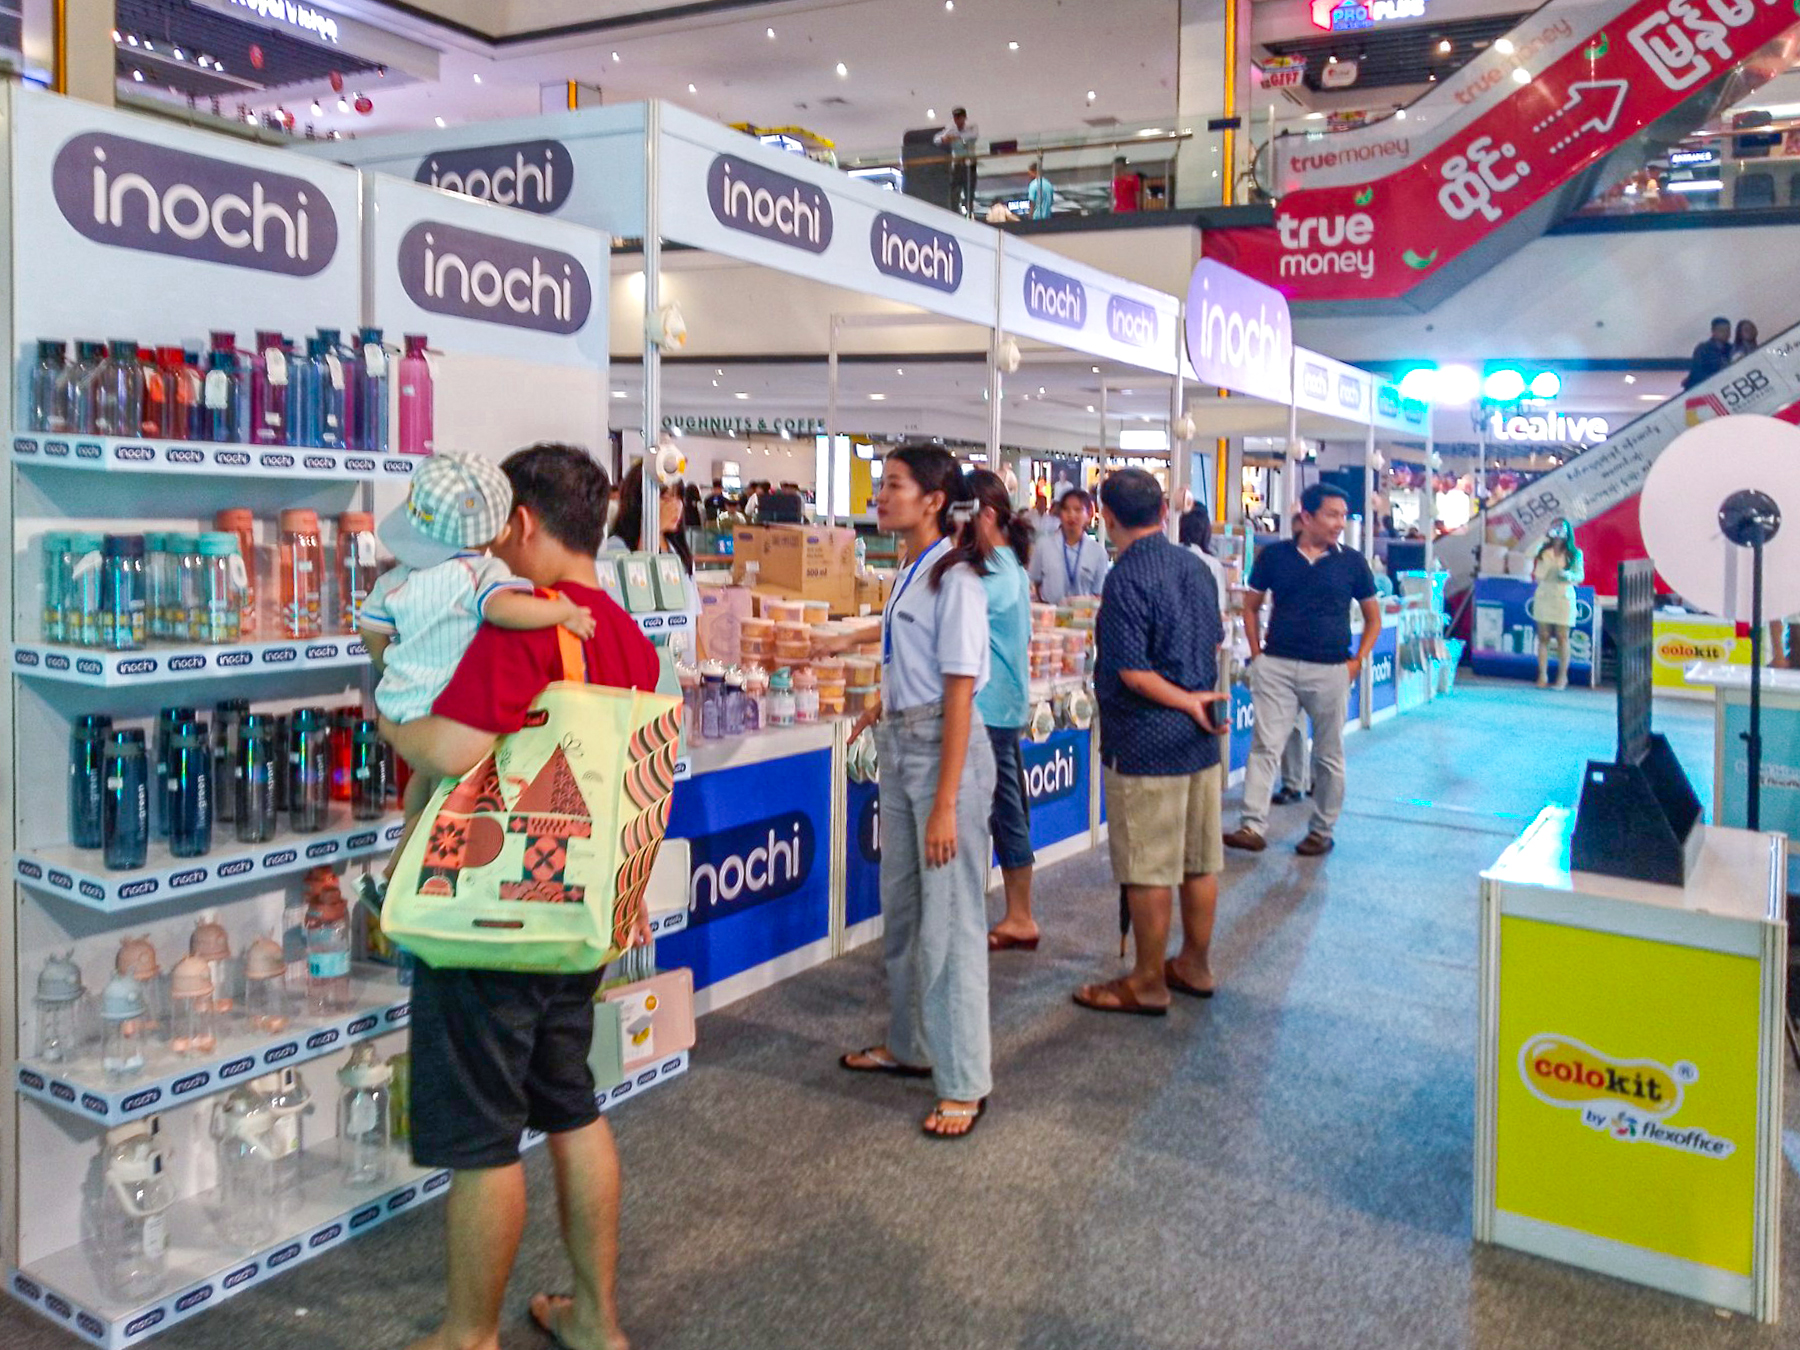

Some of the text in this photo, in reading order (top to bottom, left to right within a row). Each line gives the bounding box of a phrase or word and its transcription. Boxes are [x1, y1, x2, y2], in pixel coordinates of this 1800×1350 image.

[431, 148, 553, 205] inochi
[1290, 138, 1410, 173] truemoney
[93, 145, 309, 261] inochi
[723, 162, 820, 244] inochi
[881, 219, 954, 285] inochi
[1277, 212, 1375, 249] true
[424, 231, 572, 322] inochi
[1279, 249, 1375, 280] money
[1030, 271, 1081, 323] inochi
[1112, 300, 1154, 348] inochi
[1200, 276, 1284, 374] inochi
[1720, 369, 1770, 407] 5BB
[661, 415, 752, 431] OUGHNUTS
[773, 417, 826, 433] COFFE
[1491, 411, 1609, 442] tealive
[118, 446, 151, 460] inochi
[169, 448, 202, 462] inochi
[217, 452, 248, 464] inochi
[120, 660, 153, 674] inochi
[171, 656, 204, 669] inochi
[219, 653, 250, 665] inochi
[1372, 655, 1392, 683] nochi
[1661, 643, 1720, 659] colokit
[1023, 746, 1073, 797] ochi
[121, 880, 155, 897] inochi
[172, 870, 204, 886] inochi
[690, 822, 799, 912] nochi
[1534, 1058, 1662, 1101] colokit
[1585, 1109, 1725, 1154] by flexoffice
